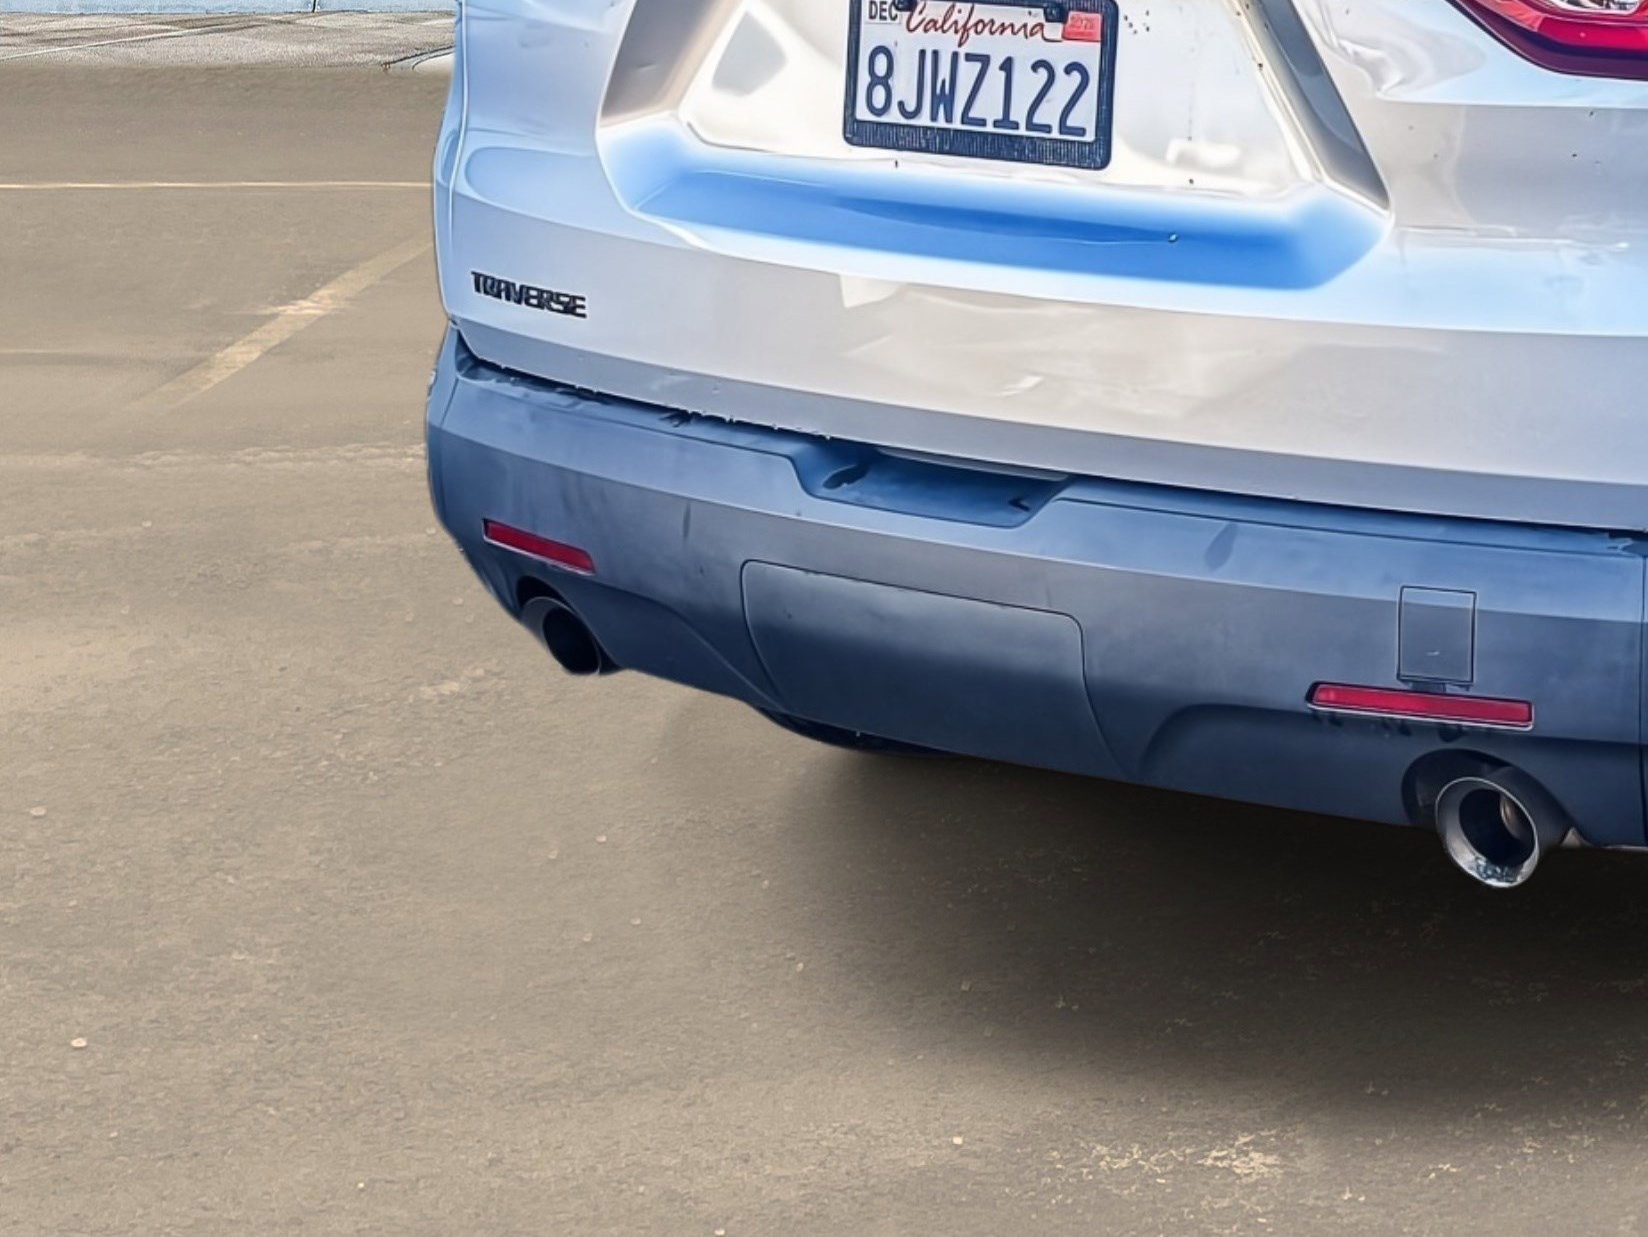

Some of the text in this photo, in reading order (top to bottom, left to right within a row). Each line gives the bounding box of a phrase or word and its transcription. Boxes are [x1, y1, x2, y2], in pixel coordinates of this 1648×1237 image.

[868, 0, 899, 22] DEC
[906, 3, 1063, 48] California
[865, 45, 1091, 137] 8JWZ122
